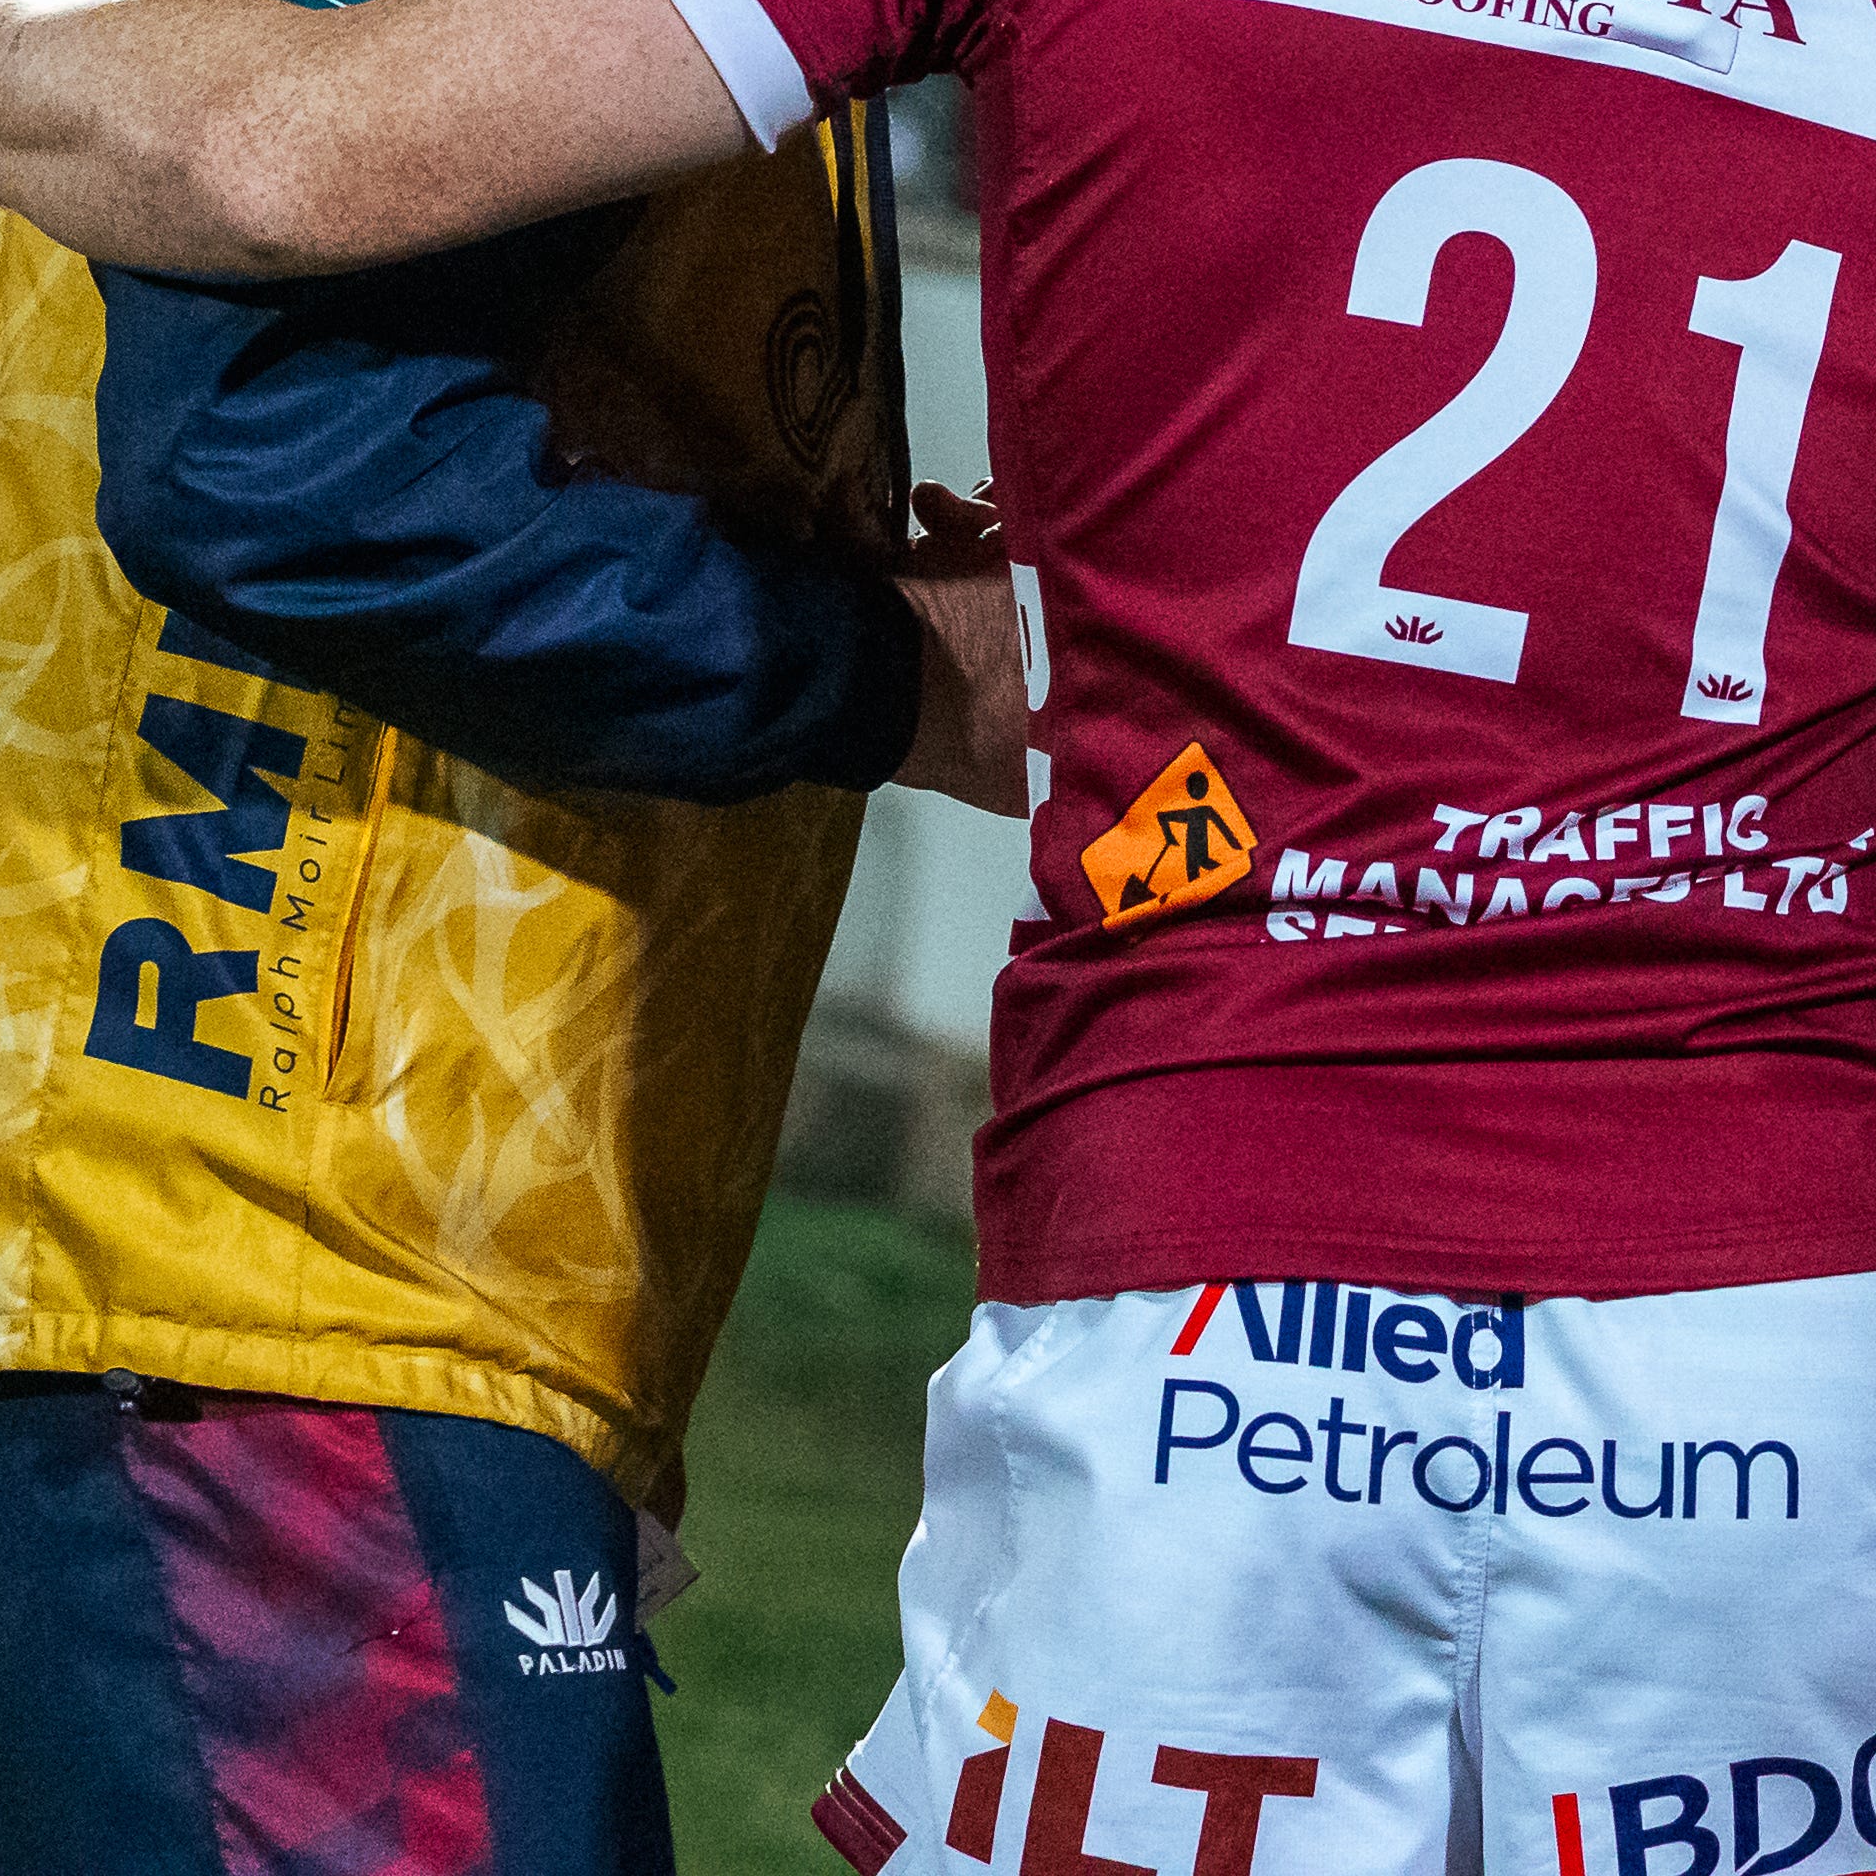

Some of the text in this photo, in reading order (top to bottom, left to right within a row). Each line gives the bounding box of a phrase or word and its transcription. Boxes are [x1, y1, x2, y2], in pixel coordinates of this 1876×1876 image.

[1286, 157, 1843, 726] 21
[279, 804, 335, 932] Moir
[1432, 794, 1769, 864] TRAFFIC
[257, 953, 302, 1113] Ralph
[1169, 1279, 1525, 1391] Allied
[1153, 1377, 1800, 1521] Petroleum
